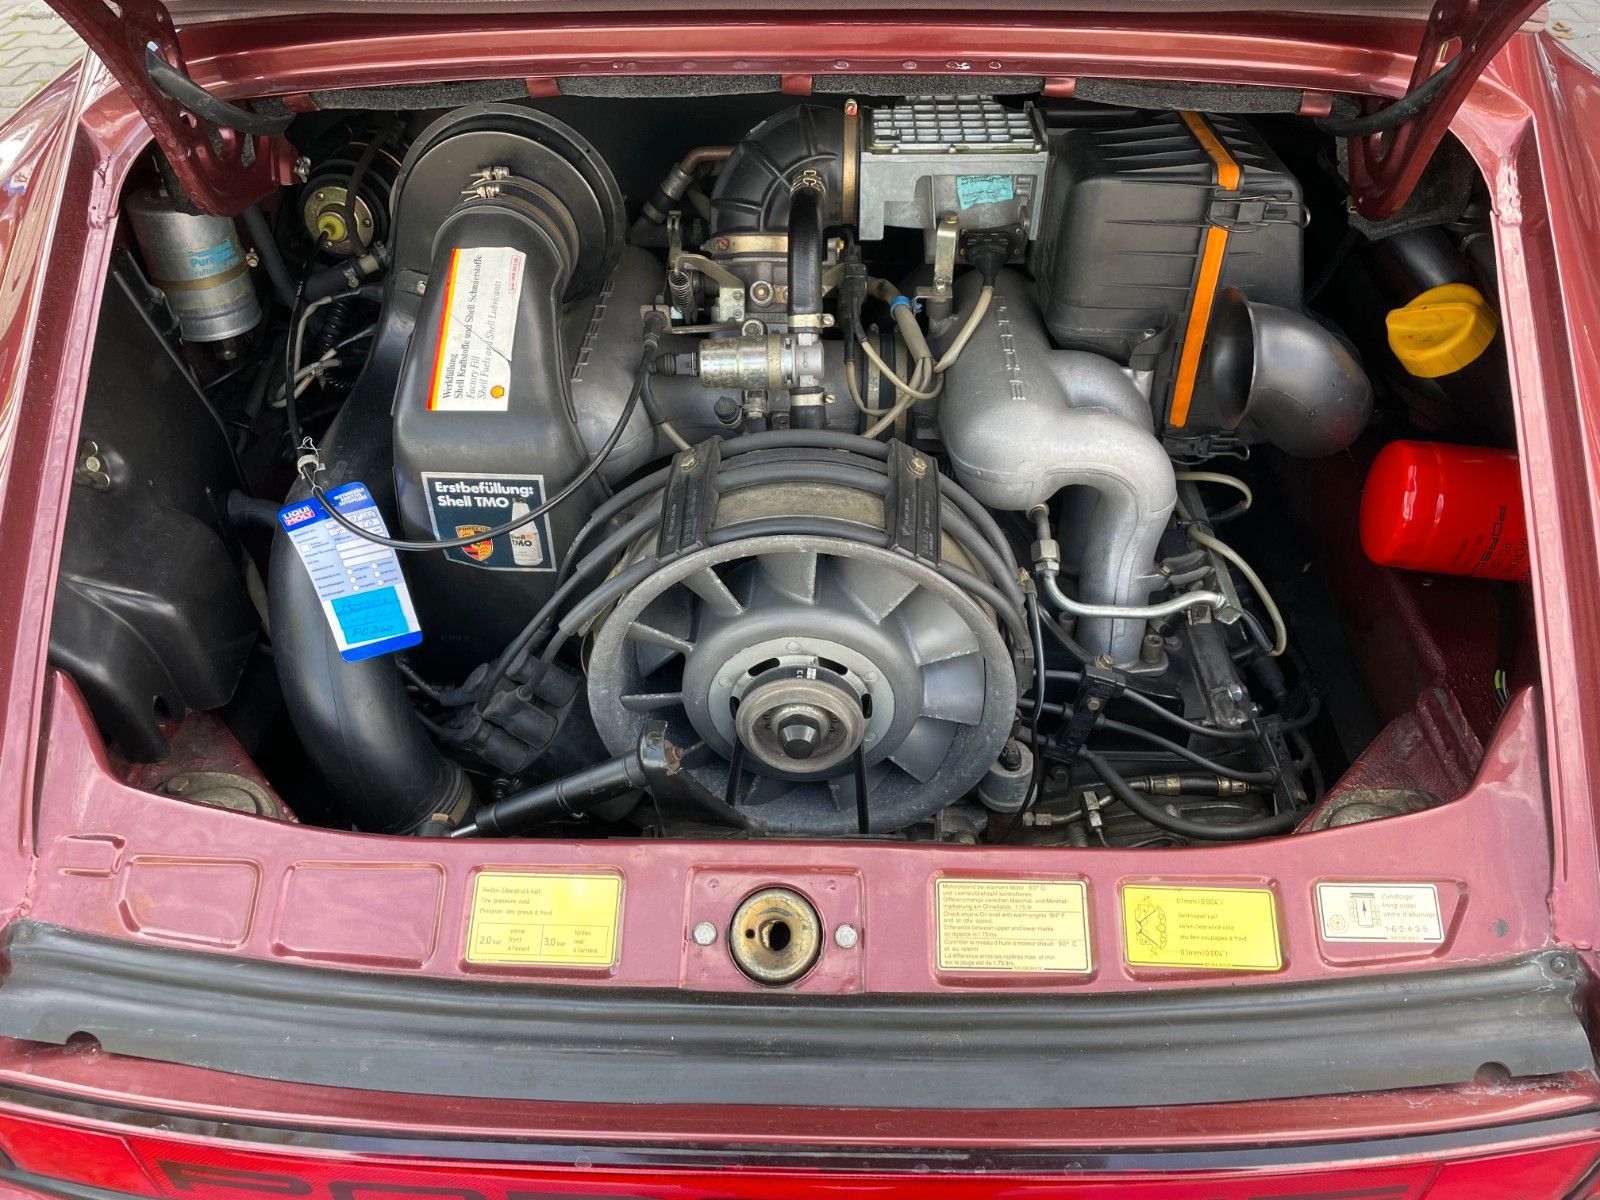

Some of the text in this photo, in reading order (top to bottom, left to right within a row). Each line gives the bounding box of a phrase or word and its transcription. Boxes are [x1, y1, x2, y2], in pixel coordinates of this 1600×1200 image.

[454, 255, 482, 399] Shell Kraftstoffe und Shell Schmierstoffe
[486, 320, 496, 340] Shell
[485, 341, 493, 356] and
[481, 357, 491, 377] Fuels
[467, 356, 480, 399] Factory Fill
[478, 379, 488, 399] Shell
[434, 481, 534, 498] Erstbefüllung:
[437, 495, 509, 508] Shell TMO
[283, 505, 312, 519] LIQUI
[285, 511, 315, 526] MOLY
